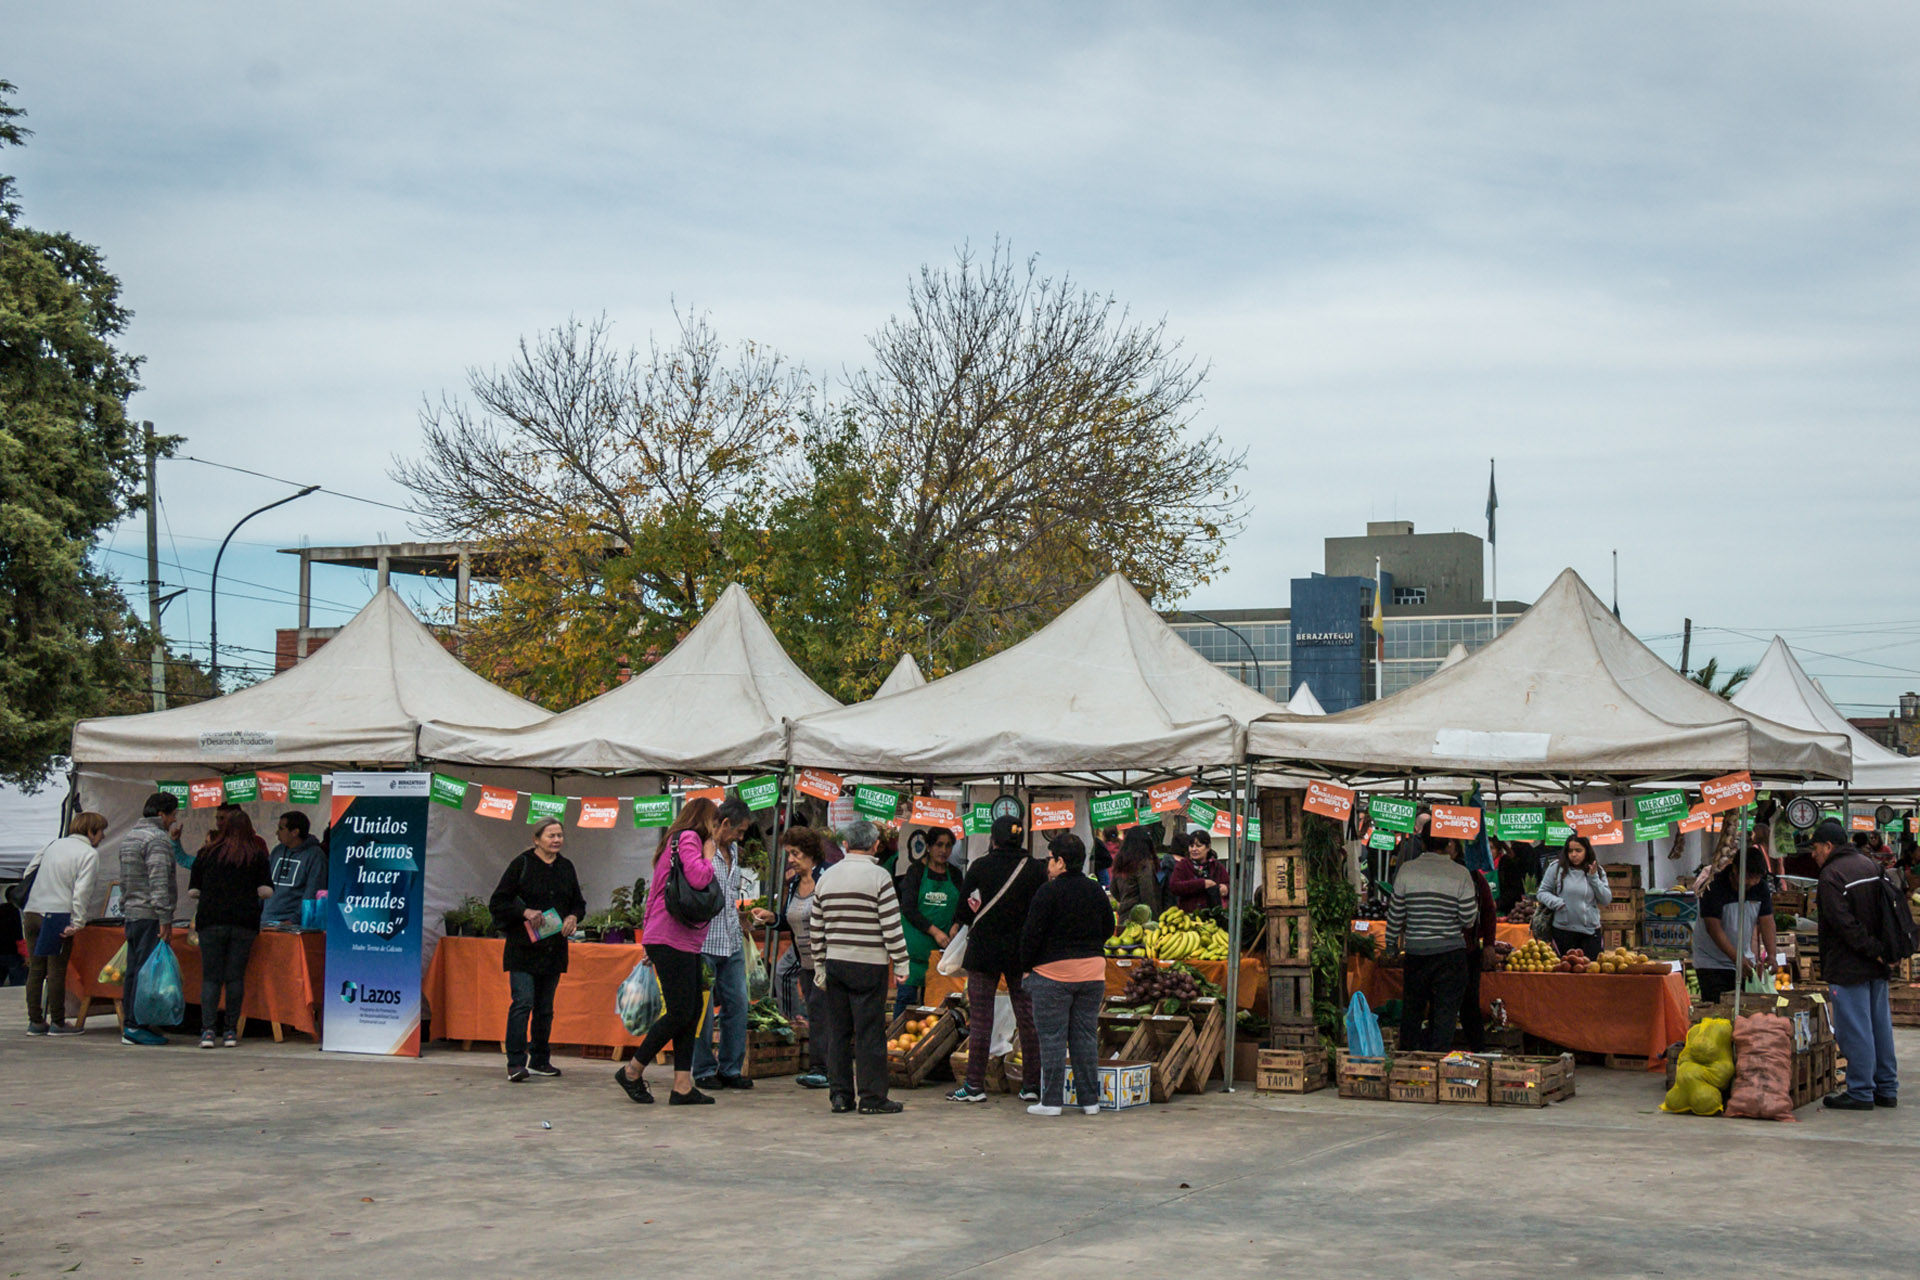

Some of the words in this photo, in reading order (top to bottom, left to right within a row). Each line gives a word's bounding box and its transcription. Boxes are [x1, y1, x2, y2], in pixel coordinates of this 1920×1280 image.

[1296, 632, 1354, 640] BERAZATEGUI
[742, 782, 776, 799] MERCADO
[858, 788, 896, 806] MERCADO
[636, 802, 670, 814] MERCADO
[1093, 797, 1131, 814] MERCADO
[1373, 801, 1414, 817] MERCADO
[1639, 793, 1683, 812] MERCADO
[345, 816, 408, 834] “Unidos
[1501, 813, 1543, 824] MERCADO
[345, 841, 413, 864] podemos
[357, 866, 400, 884] hacer
[1276, 863, 1287, 890] TAPIA
[344, 891, 406, 914] grandes
[352, 917, 405, 935] cosas”.
[361, 984, 401, 1004] Lazos
[1266, 1075, 1293, 1087] TAPIA
[1400, 1087, 1425, 1098] TAPIA
[1449, 1086, 1477, 1098] TAPIA
[1501, 1090, 1530, 1102] TAPIA
